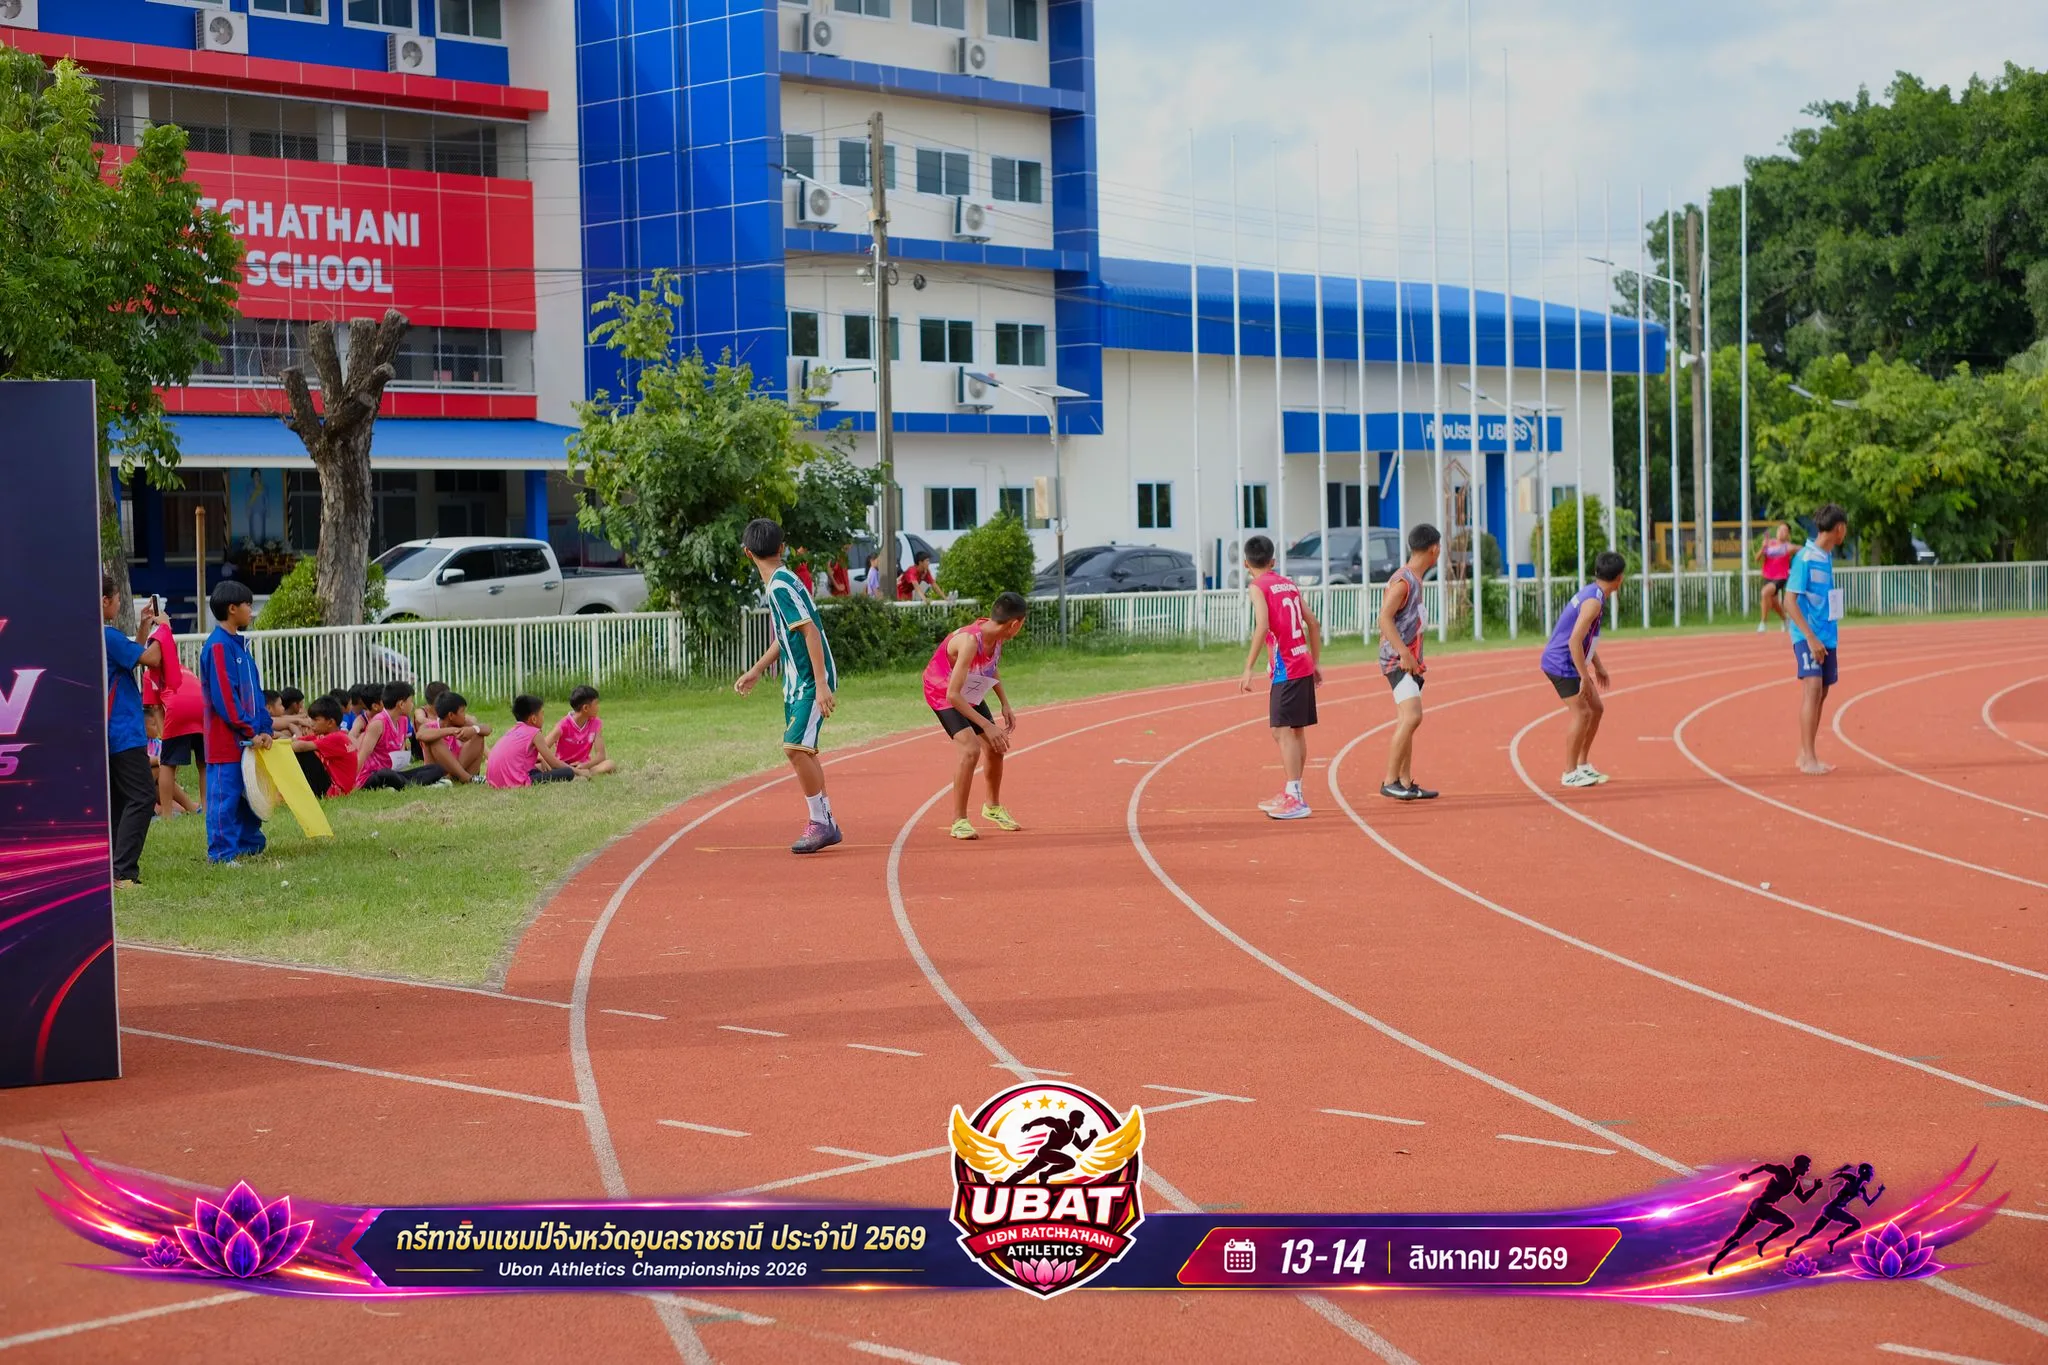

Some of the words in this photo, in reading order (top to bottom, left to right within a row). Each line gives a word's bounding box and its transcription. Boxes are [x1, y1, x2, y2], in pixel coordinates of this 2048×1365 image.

[246, 250, 394, 293] SCHOOL
[1282, 595, 1304, 639] 21
[966, 680, 981, 694] 7
